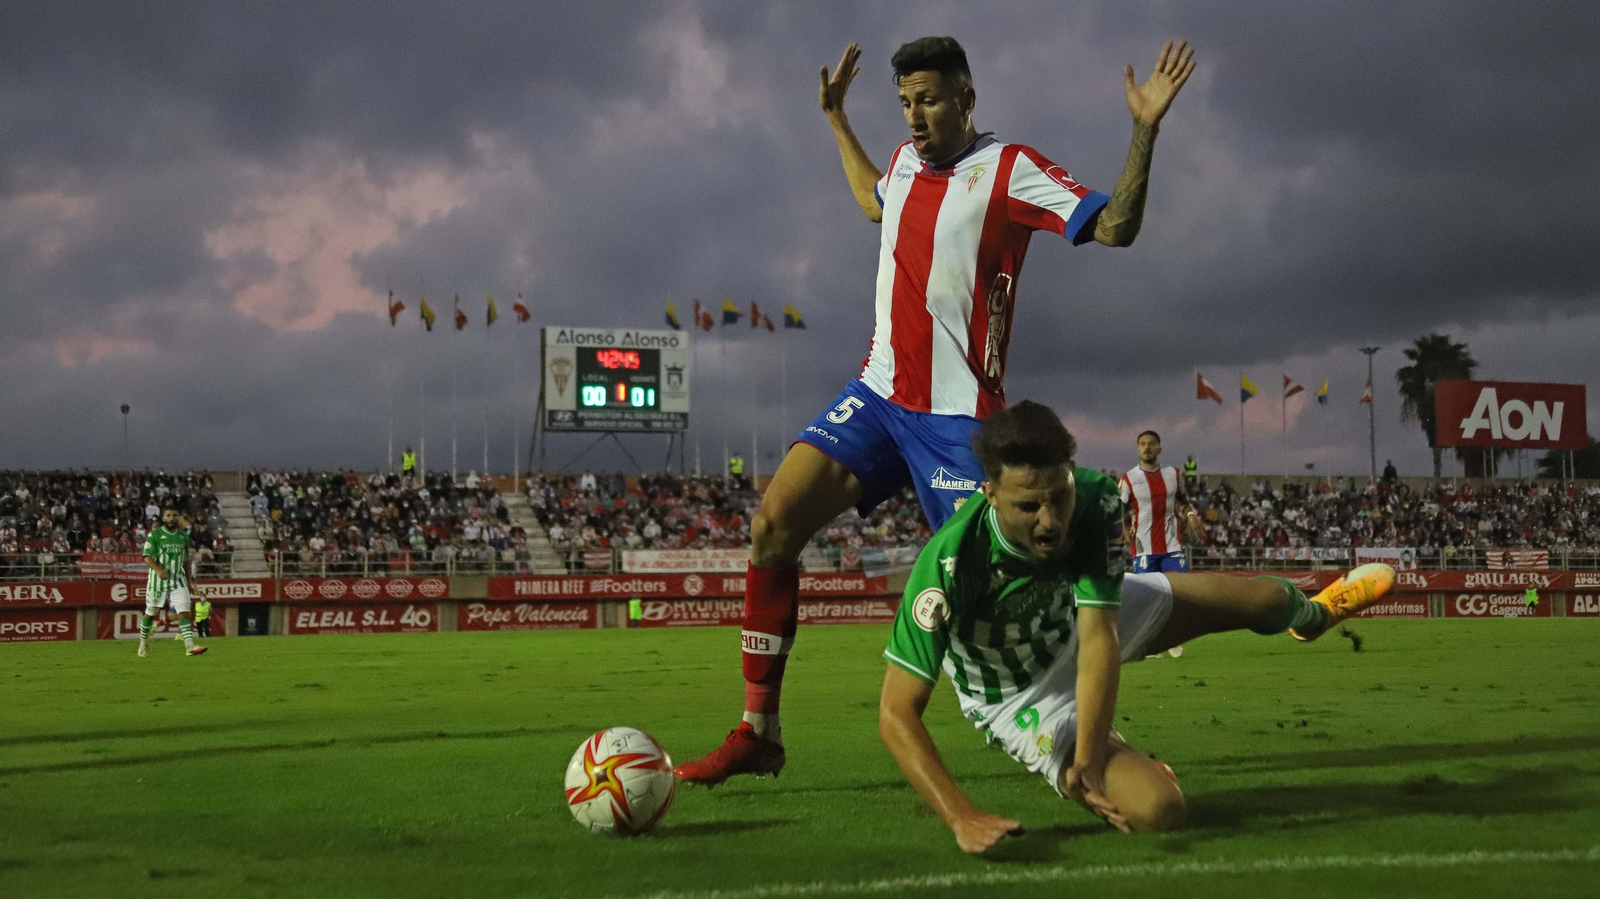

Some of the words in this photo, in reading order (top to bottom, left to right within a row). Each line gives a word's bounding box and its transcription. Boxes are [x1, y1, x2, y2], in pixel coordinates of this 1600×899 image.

[582, 385, 606, 406] 00
[616, 382, 626, 401] 1
[631, 387, 655, 407] 01
[826, 396, 865, 424] 5
[1459, 387, 1564, 441] AON
[515, 580, 560, 595] PRIMERA
[605, 579, 667, 593] Footters
[805, 577, 865, 590] Footters
[466, 603, 510, 627] Pepe
[513, 603, 588, 623] Valencia
[1573, 595, 1600, 613] AL
[296, 610, 356, 628] ELEAL
[361, 610, 395, 626] S.L.
[400, 605, 431, 627] 40
[674, 612, 746, 620] PERMOTOR
